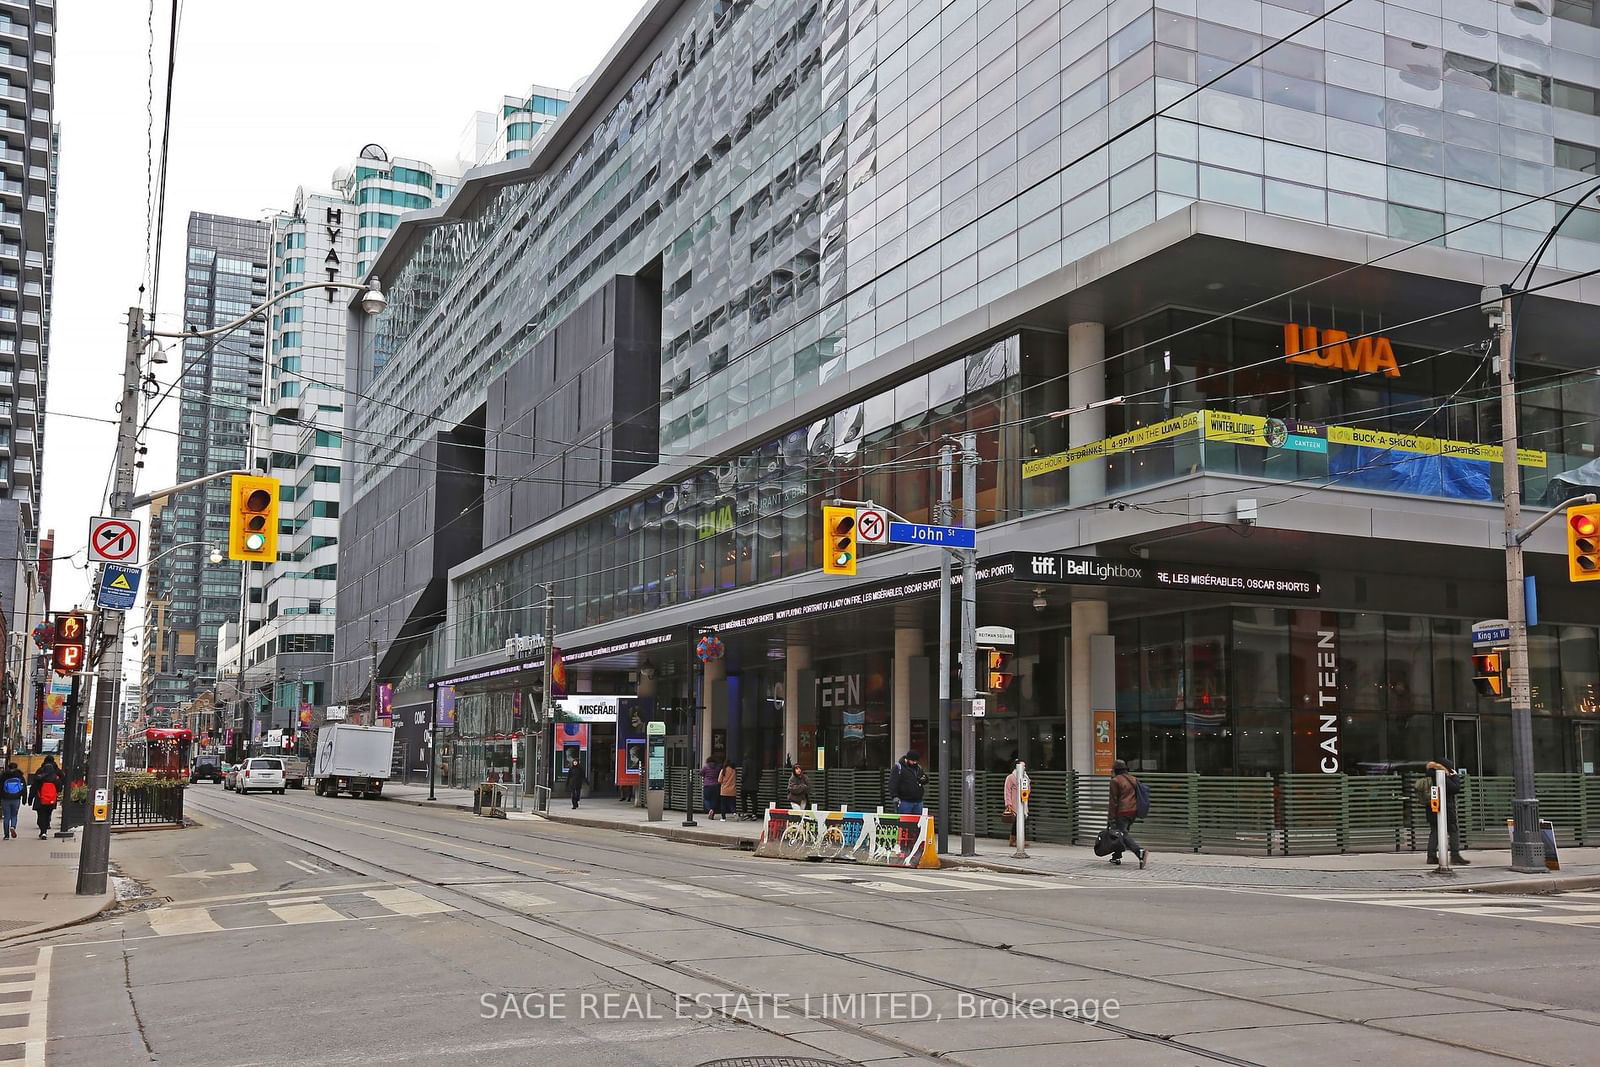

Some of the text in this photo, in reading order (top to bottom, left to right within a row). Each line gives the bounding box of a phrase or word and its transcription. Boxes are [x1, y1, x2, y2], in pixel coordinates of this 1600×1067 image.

[325, 207, 342, 304] HYATT
[1284, 323, 1401, 377] LUMA
[1210, 419, 1255, 435] WINTERLICIOUS
[1296, 424, 1318, 435] LUMA
[1024, 462, 1044, 474] MAGIC
[1045, 456, 1062, 469] HOUR
[1076, 445, 1103, 460] DRINKS
[1136, 433, 1144, 442] IN
[1146, 429, 1160, 440] THE
[1161, 421, 1181, 435] LUMA
[1182, 416, 1198, 429] BAR
[1294, 440, 1321, 449] CANTEEN
[1353, 432, 1376, 444] BUCK
[1389, 437, 1417, 449] SHUCK
[1450, 445, 1481, 456] OYSTERS
[1481, 448, 1500, 458] FROM
[911, 525, 955, 541] John St
[108, 564, 140, 575] ATTENTION
[862, 592, 872, 603] LES
[904, 582, 922, 595] OSCAR
[923, 578, 941, 591] SHORT
[1172, 573, 1190, 584] LES
[1190, 573, 1246, 589] MISÉRABLES,
[1246, 578, 1275, 590] OSCAR
[1276, 579, 1310, 593] SHORTS
[1477, 631, 1492, 641] King
[1499, 629, 1506, 638] W
[414, 711, 426, 725] COME
